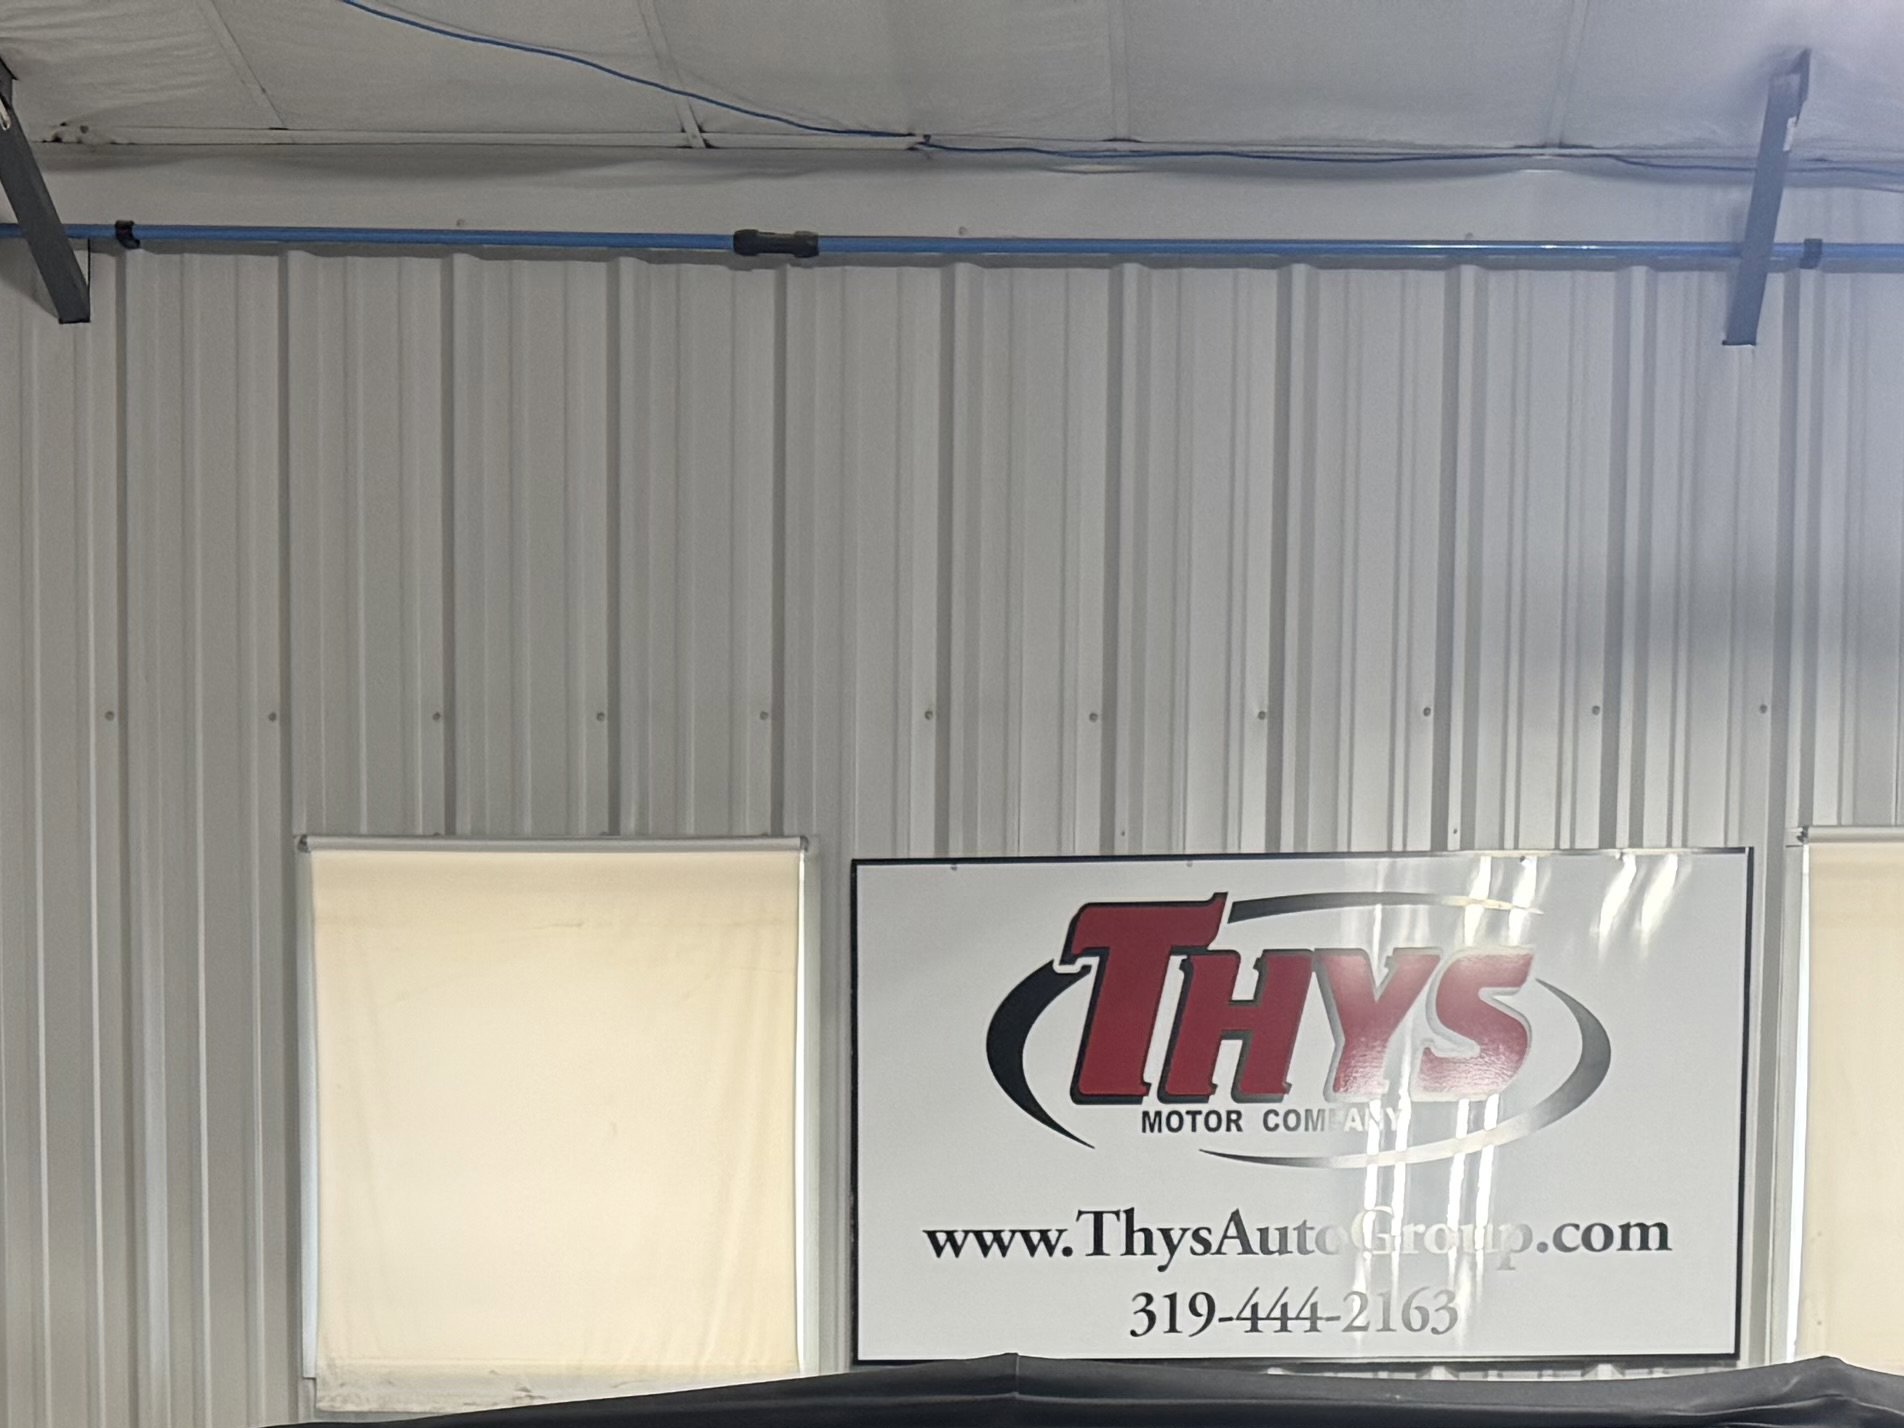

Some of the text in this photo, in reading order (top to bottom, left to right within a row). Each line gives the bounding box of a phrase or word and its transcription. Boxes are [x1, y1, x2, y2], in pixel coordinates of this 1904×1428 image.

[1058, 891, 1534, 1104] THYS
[1141, 1108, 1401, 1133] MOTOR COMANY
[922, 1207, 1672, 1272] www.ThysAutoGroup.com
[1129, 1286, 1459, 1338] 319-444-2163
